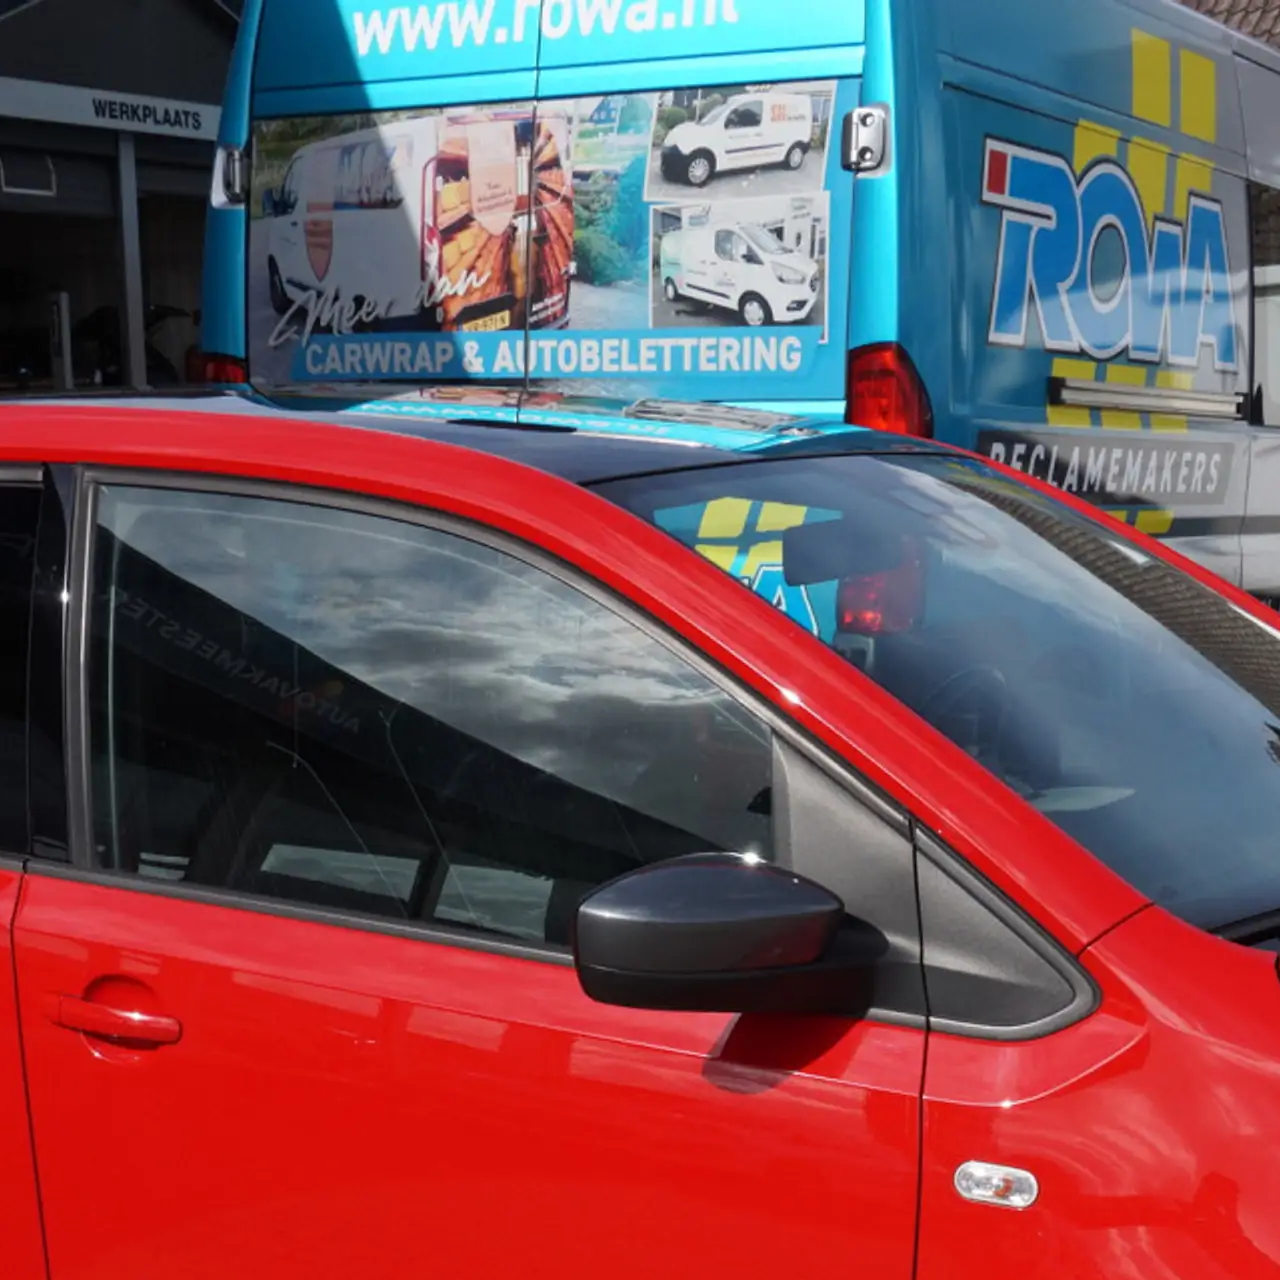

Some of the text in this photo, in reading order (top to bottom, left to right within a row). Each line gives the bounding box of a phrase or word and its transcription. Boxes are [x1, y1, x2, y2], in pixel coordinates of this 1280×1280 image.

[92, 97, 202, 131] WERKPLAATS
[982, 135, 1237, 373] ROWA
[305, 335, 803, 375] CARWRAP & AUTOBELETTERING
